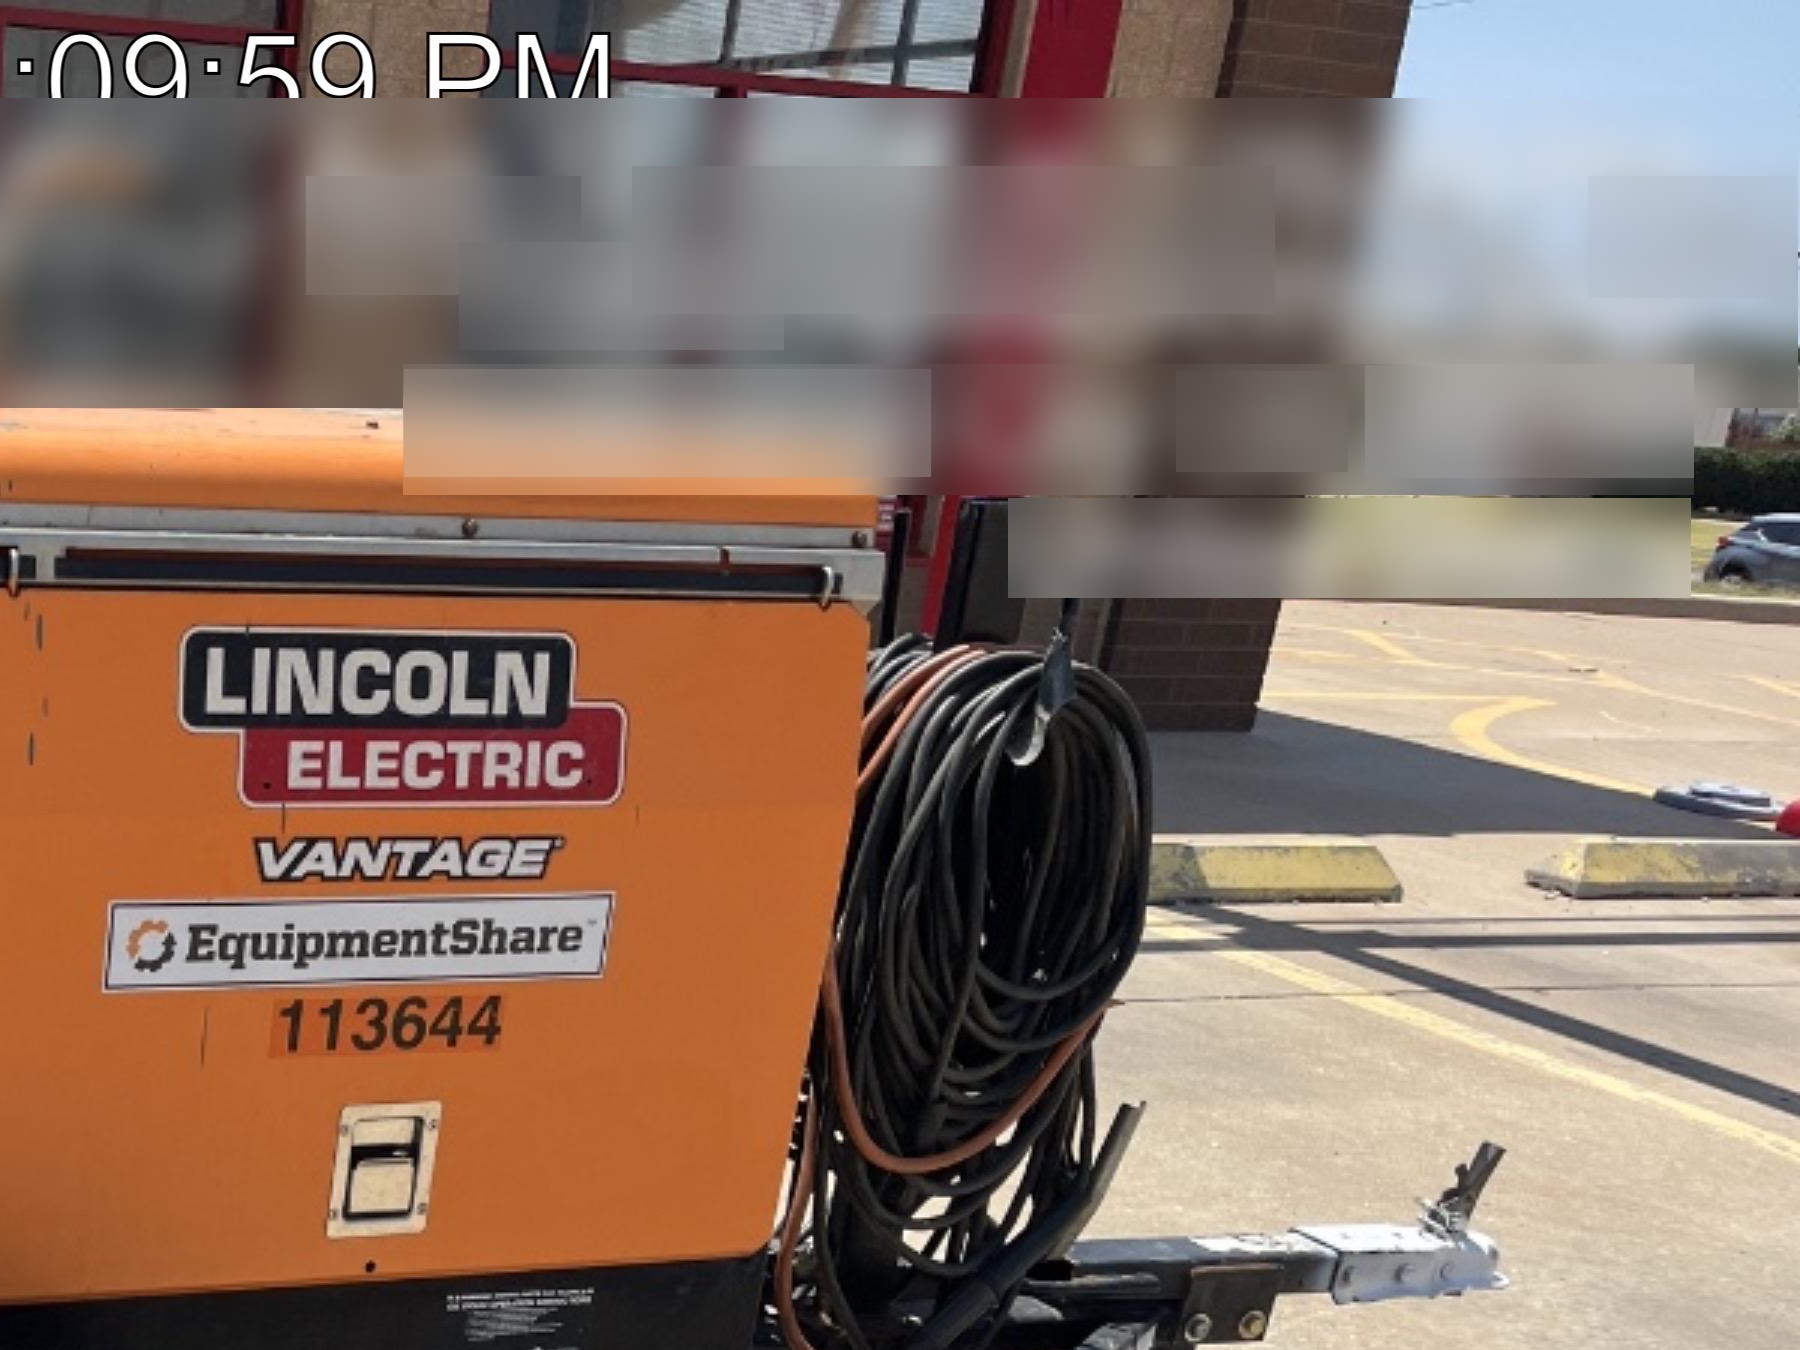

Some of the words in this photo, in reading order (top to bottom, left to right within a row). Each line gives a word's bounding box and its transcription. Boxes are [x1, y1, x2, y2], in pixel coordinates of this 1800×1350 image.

[204, 646, 551, 717] LINCOLN
[286, 739, 586, 791] ELECTRIC
[253, 835, 556, 882] VANTAGE
[185, 918, 584, 970] EquipmentShare
[278, 995, 504, 1054] 113644
